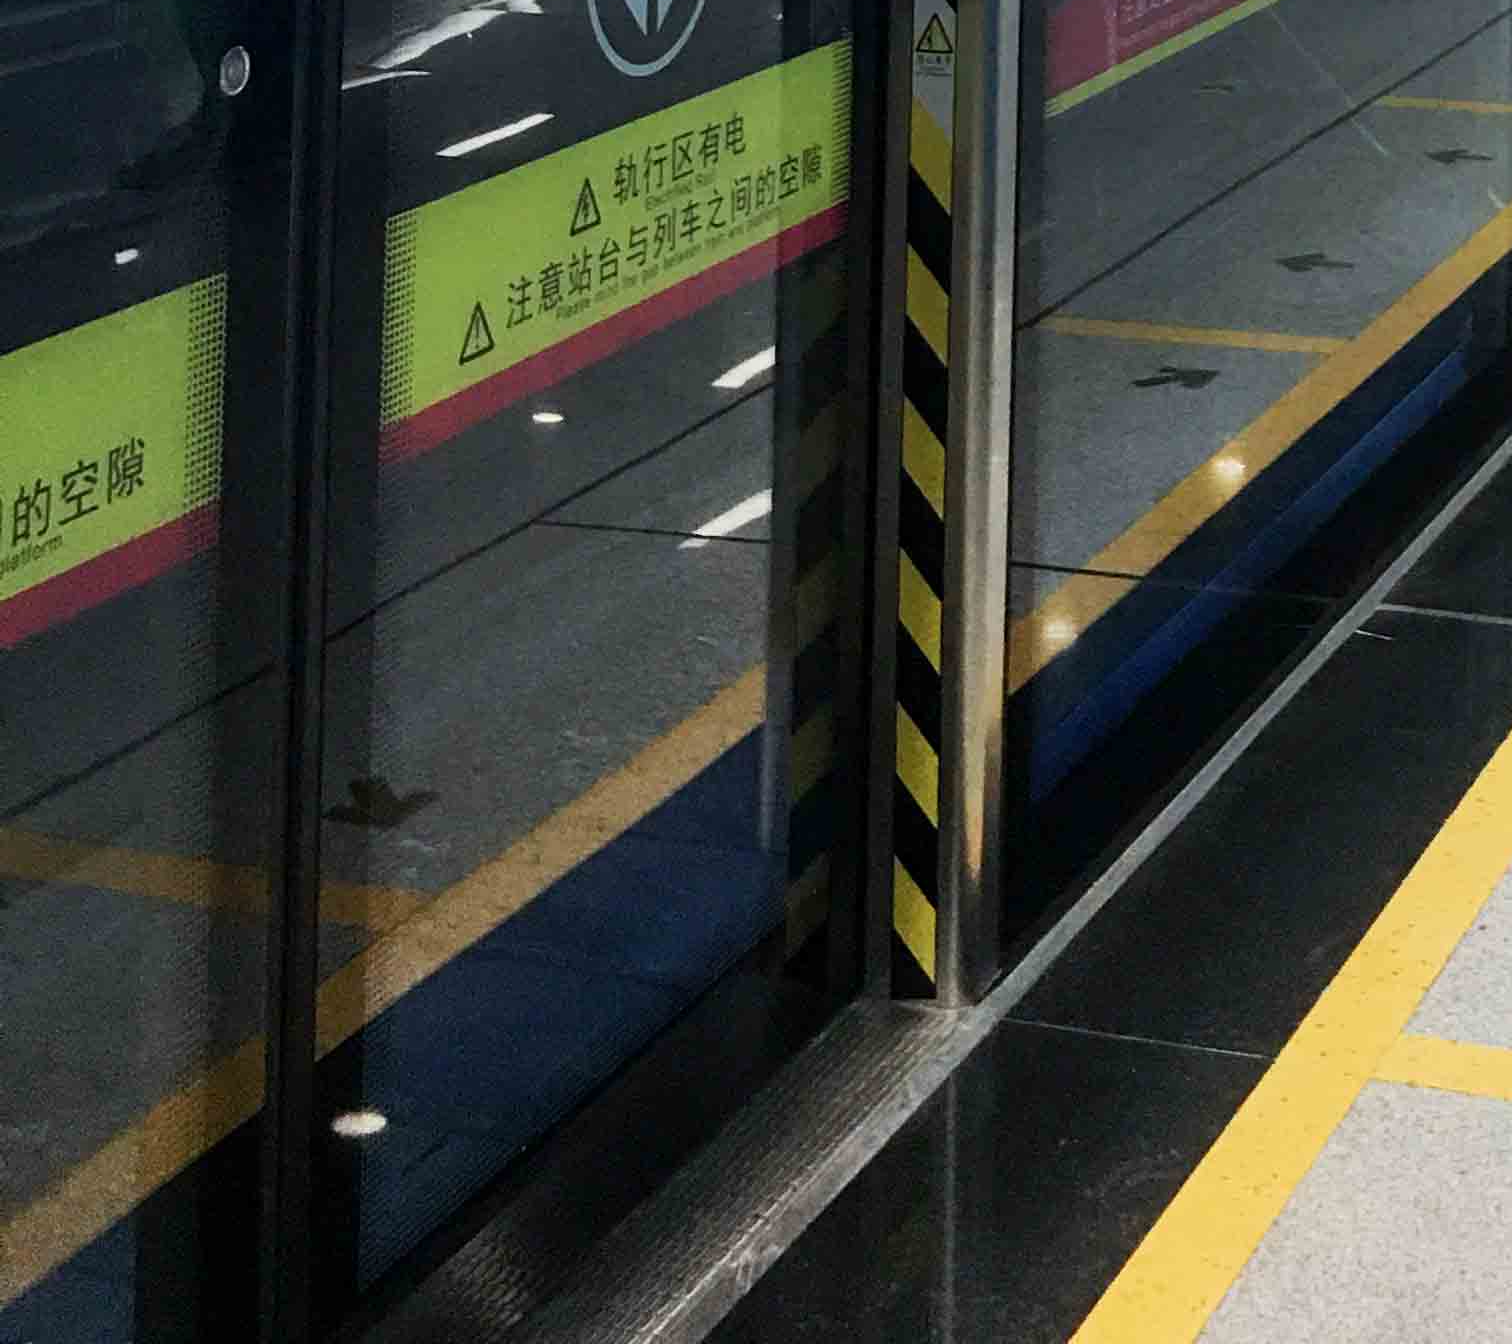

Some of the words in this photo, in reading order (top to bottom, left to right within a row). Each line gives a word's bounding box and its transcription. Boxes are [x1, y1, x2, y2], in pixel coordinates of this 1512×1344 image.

[613, 112, 747, 205] 轨行区有电
[505, 144, 824, 329] 注意站台与列车之间的空隙
[0, 436, 145, 548] 的空隙
